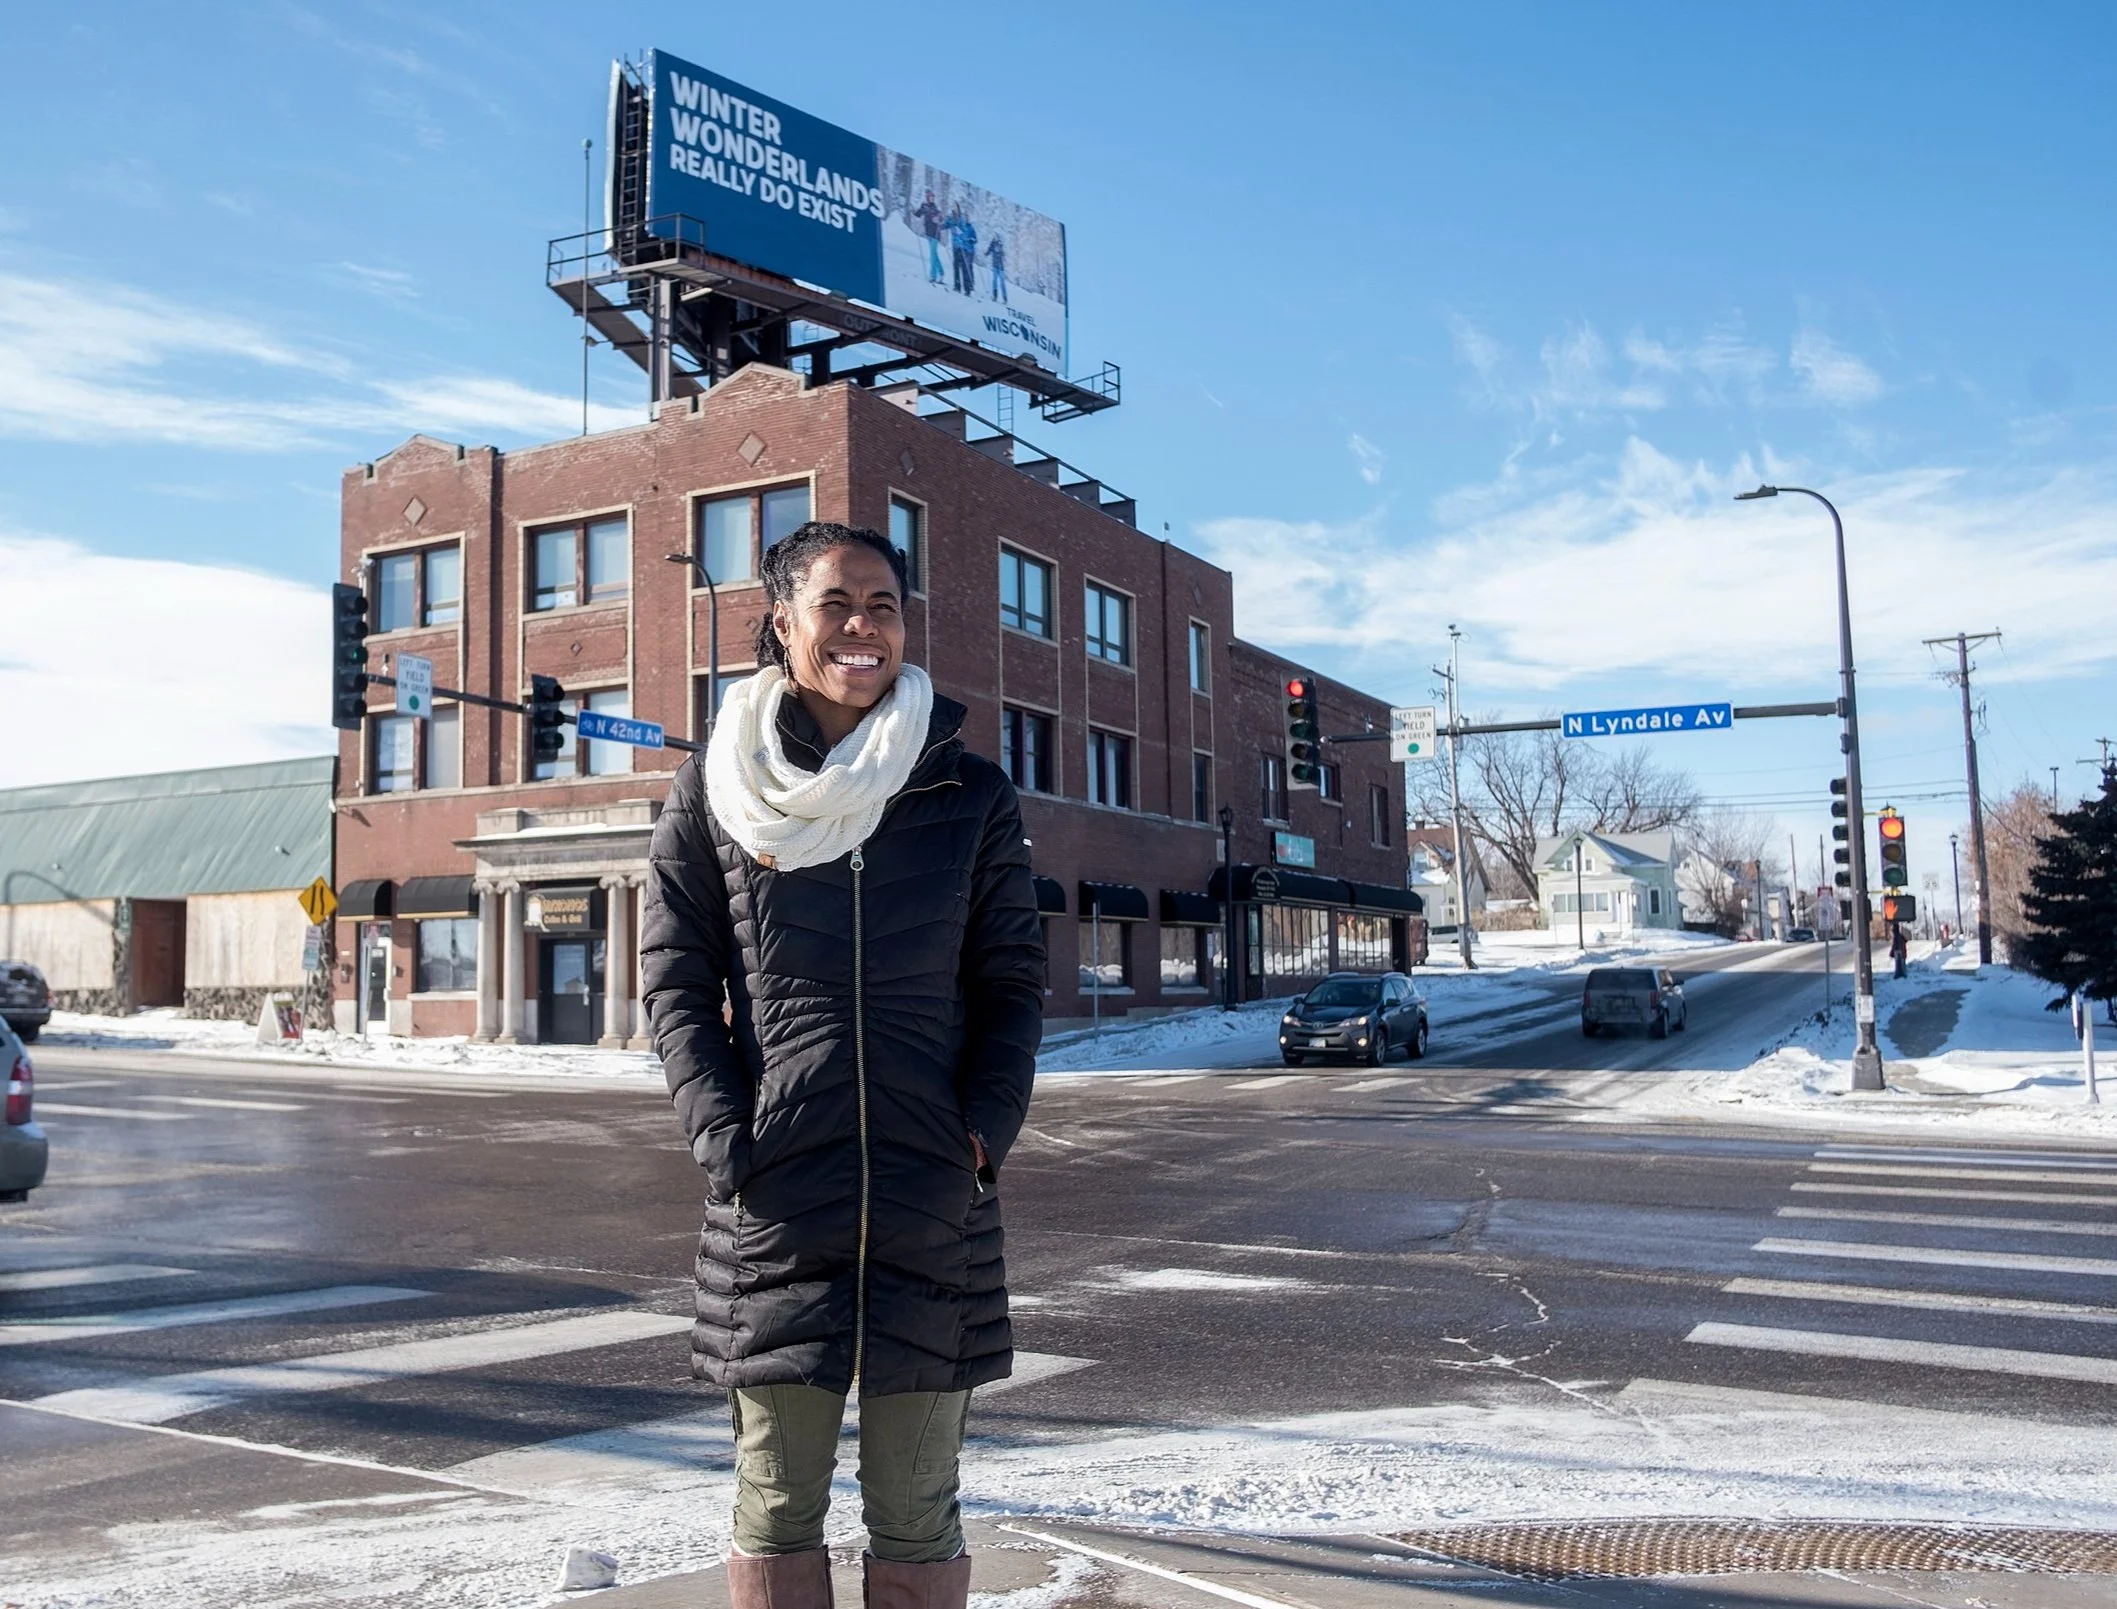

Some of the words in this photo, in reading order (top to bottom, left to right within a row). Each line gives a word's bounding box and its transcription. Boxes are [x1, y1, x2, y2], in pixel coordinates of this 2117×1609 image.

[670, 71, 782, 145] WINTER
[670, 107, 886, 218] WONDERLANDS
[670, 144, 756, 196] REALLY
[760, 176, 795, 210] DO
[798, 191, 857, 233] EXIST
[1006, 307, 1037, 327] TRAVEL
[1403, 720, 1425, 730] YIELD
[1415, 710, 1432, 718] TURN
[1568, 715, 1583, 734] N
[1592, 711, 1684, 735] Lyndale
[1695, 707, 1725, 726] Av
[596, 720, 607, 735] N
[609, 722, 642, 741] 42nd
[645, 728, 661, 744] Av
[1408, 731, 1431, 739] GREEN
